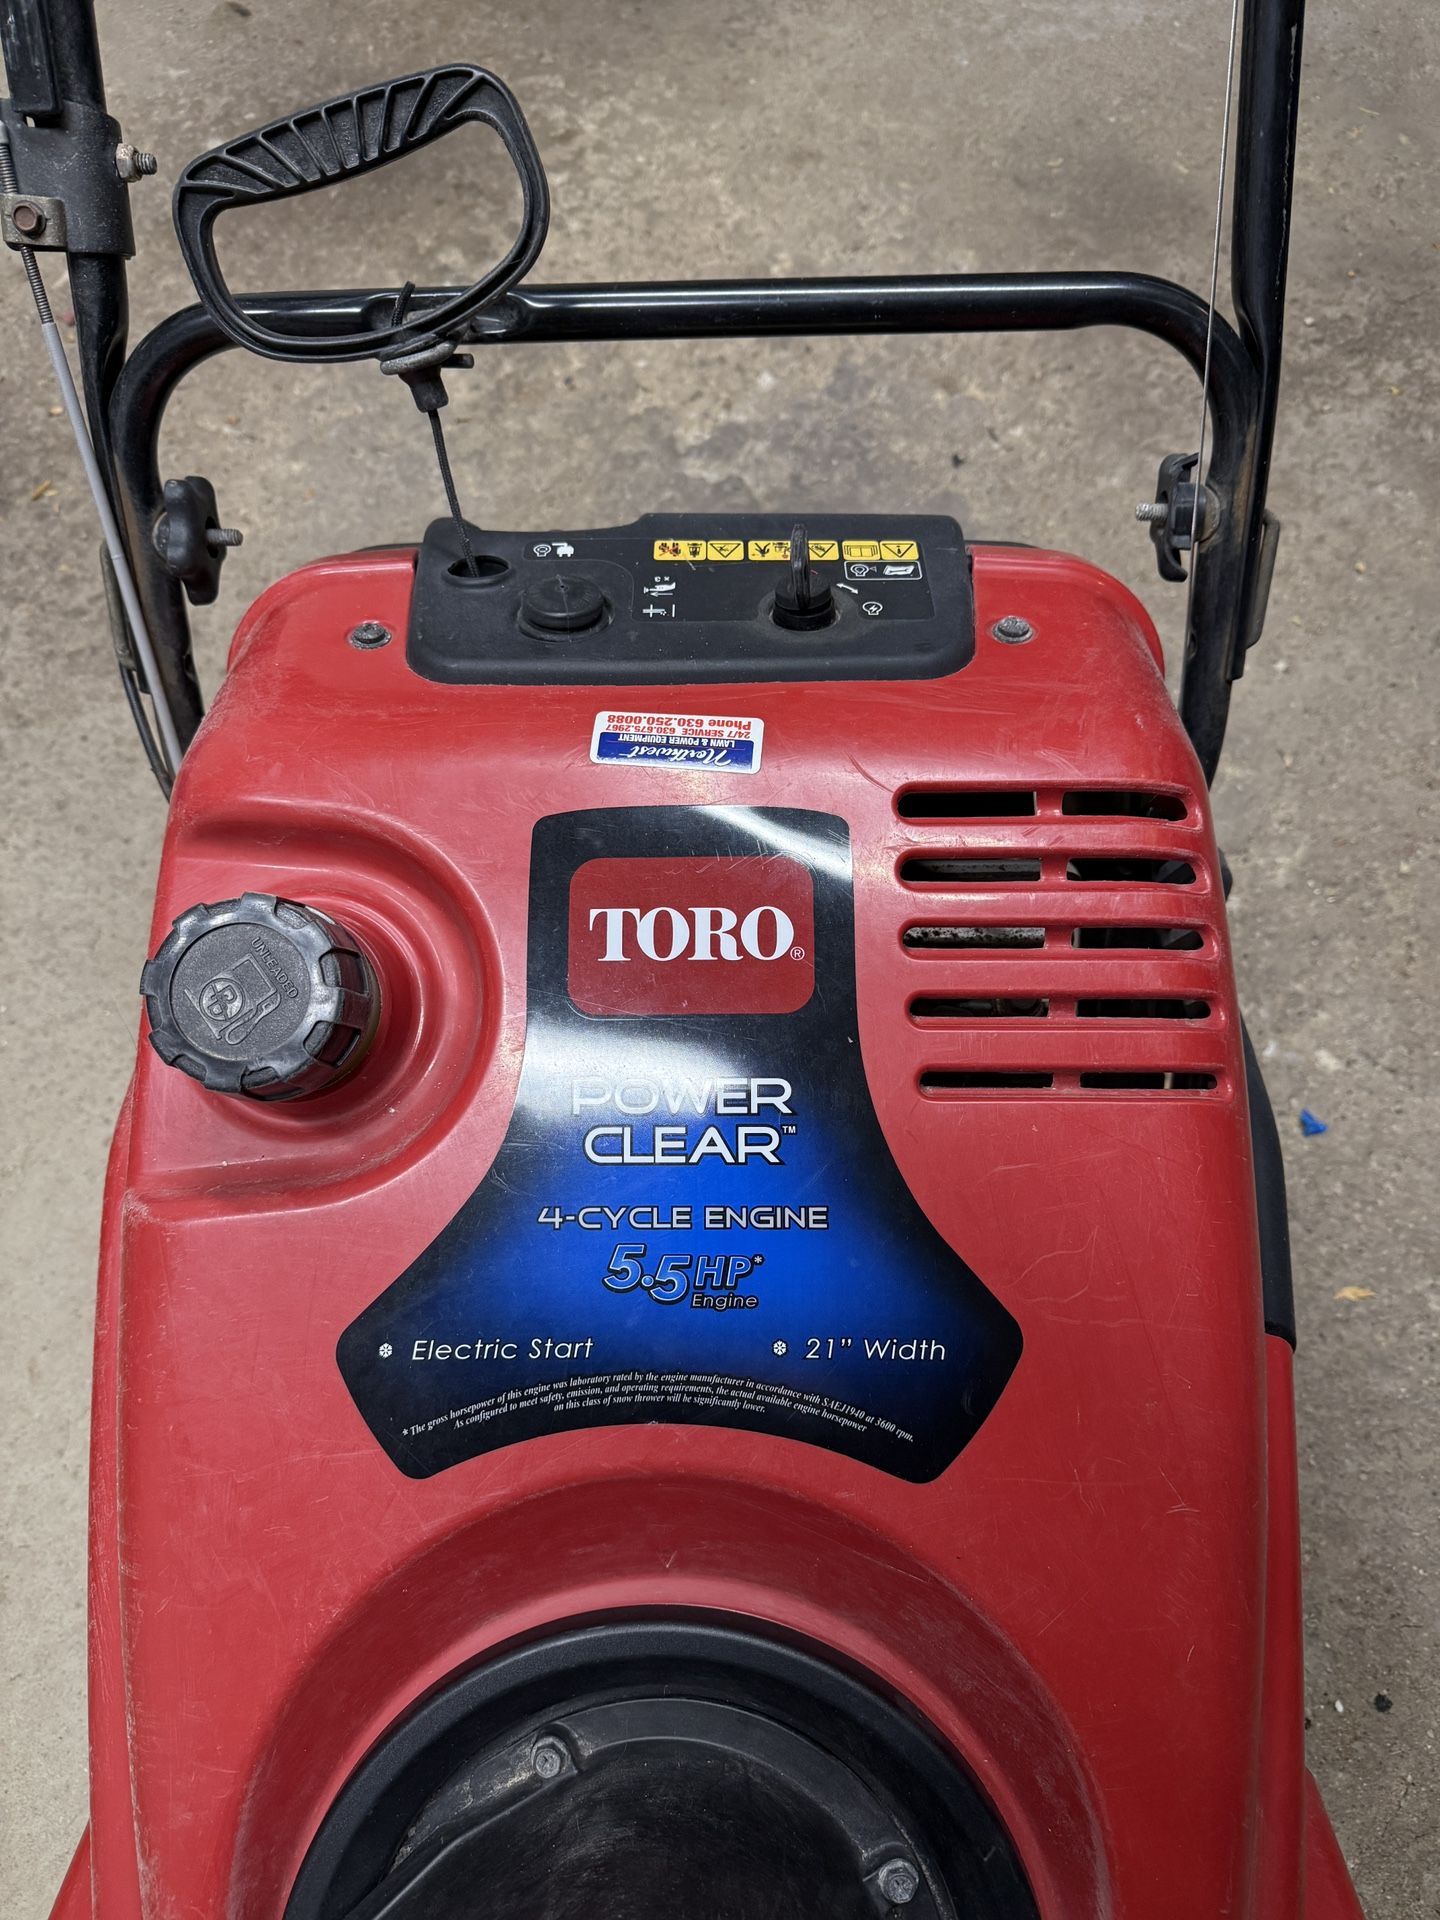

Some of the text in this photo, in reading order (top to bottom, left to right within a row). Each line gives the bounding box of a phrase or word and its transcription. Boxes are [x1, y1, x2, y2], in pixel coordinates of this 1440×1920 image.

[605, 723, 751, 739] 24/7 SERVICE 630.675.2967
[607, 714, 752, 731] Phone 630.250.0088
[618, 733, 735, 748] LAWN & POWER EQUIPMENT
[619, 745, 732, 767] Northwest
[252, 936, 299, 999] UNLEADED
[571, 1076, 794, 1116] POWER
[537, 1206, 829, 1230] 4-CYCLE ENGINE
[691, 1293, 758, 1310] Engine
[411, 1338, 594, 1361] Electric Start
[864, 1338, 946, 1360] Width
[427, 1414, 449, 1431] gross
[449, 1397, 496, 1420] horsepower
[497, 1392, 507, 1404] of
[507, 1388, 522, 1400] this
[523, 1383, 551, 1396] engine
[552, 1382, 568, 1390] was
[569, 1375, 611, 1387] laboratory
[612, 1372, 633, 1382] rated
[634, 1371, 644, 1383] by
[645, 1372, 659, 1381] the
[660, 1372, 689, 1383] engine
[689, 1374, 745, 1387] manufacturer
[745, 1378, 755, 1388] in
[755, 1383, 802, 1399] accordance
[802, 1393, 821, 1404] with
[865, 1414, 875, 1424] at
[874, 1417, 897, 1432] 3600
[895, 1428, 914, 1442] rpm.
[453, 1382, 868, 1432] As configured to meet safety, emission, and operating requirements, the actual available engine horsepower
[553, 1393, 766, 1413] on this class of snow thrower will be significantly lower.
